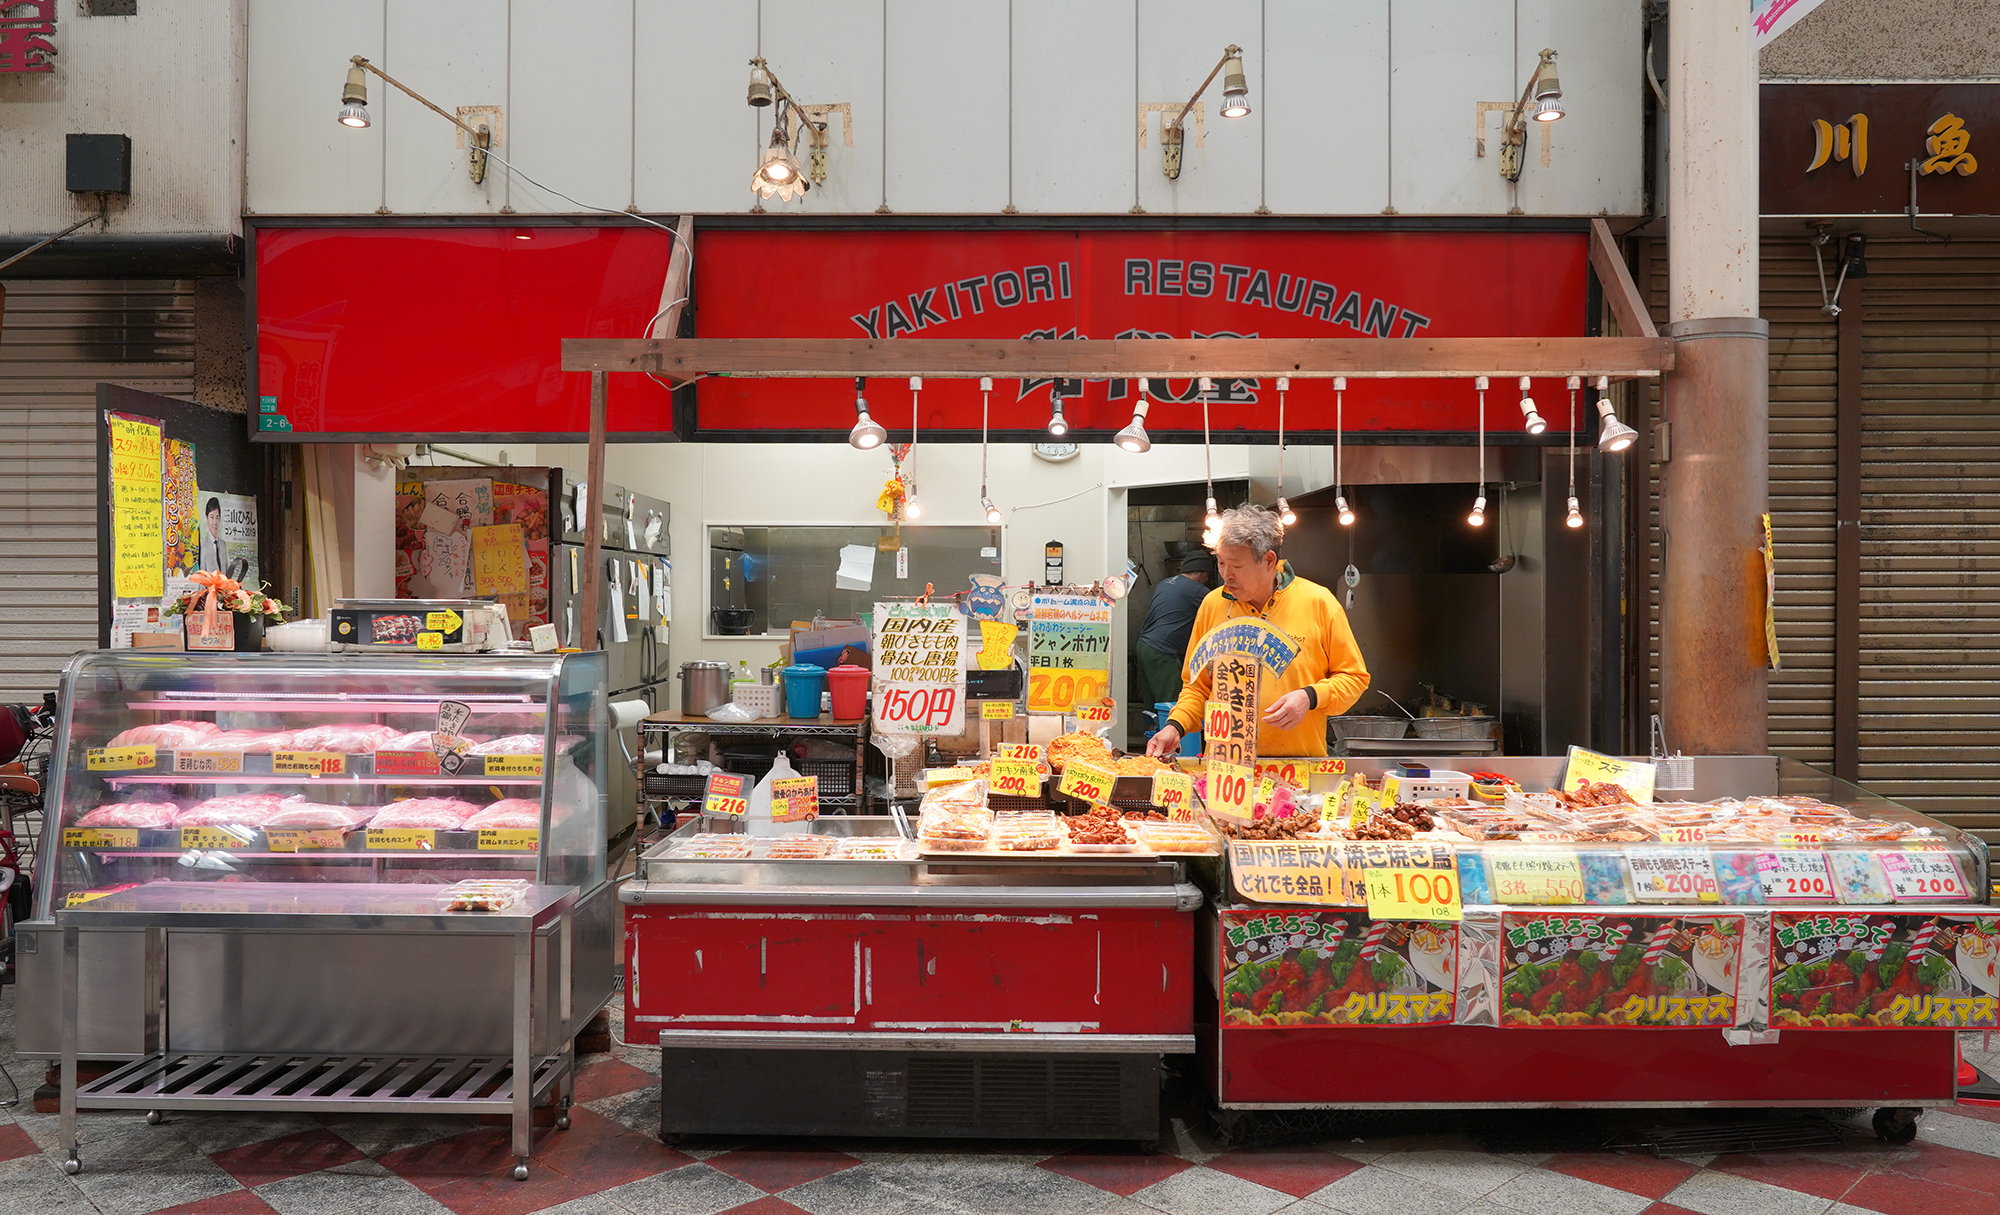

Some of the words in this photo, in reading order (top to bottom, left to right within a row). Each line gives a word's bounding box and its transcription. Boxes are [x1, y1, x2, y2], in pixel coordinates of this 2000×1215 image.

[850, 260, 1072, 340] YAKITORI
[1124, 257, 1432, 340] RESTAURANT
[223, 508, 257, 525] 三山ひろし
[881, 617, 960, 634] 国内産
[1032, 621, 1093, 633] ふわふわジューシー
[881, 633, 960, 650] 朝びきもも肉
[1033, 632, 1110, 652] ジャンボカツ
[1231, 635, 1257, 647] やきとり
[880, 650, 960, 667] 骨なし唐揚
[1262, 643, 1288, 668] やきとり
[1216, 661, 1229, 701] 全品
[880, 688, 956, 726] 150円
[1228, 658, 1246, 767] やきとり
[1006, 745, 1039, 759] ¥216
[179, 757, 212, 770] 若鶏むね肉
[1214, 773, 1246, 807] 100
[712, 797, 746, 814] ¥216
[1325, 795, 1337, 822] もも
[480, 829, 497, 837] 国内産
[1393, 872, 1453, 905] 100
[1665, 873, 1718, 894] 200円
[1786, 877, 1825, 894] 200
[1916, 877, 1956, 893] 200
[1430, 906, 1451, 917] 108
[1228, 915, 1341, 947] 家族そろって
[1508, 919, 1625, 947] 家族そろって
[1777, 918, 1888, 948] 家族そろって
[1345, 991, 1454, 1020] クリスマス
[1624, 993, 1731, 1022] クリスマス
[1890, 994, 1995, 1022] クリスマス
